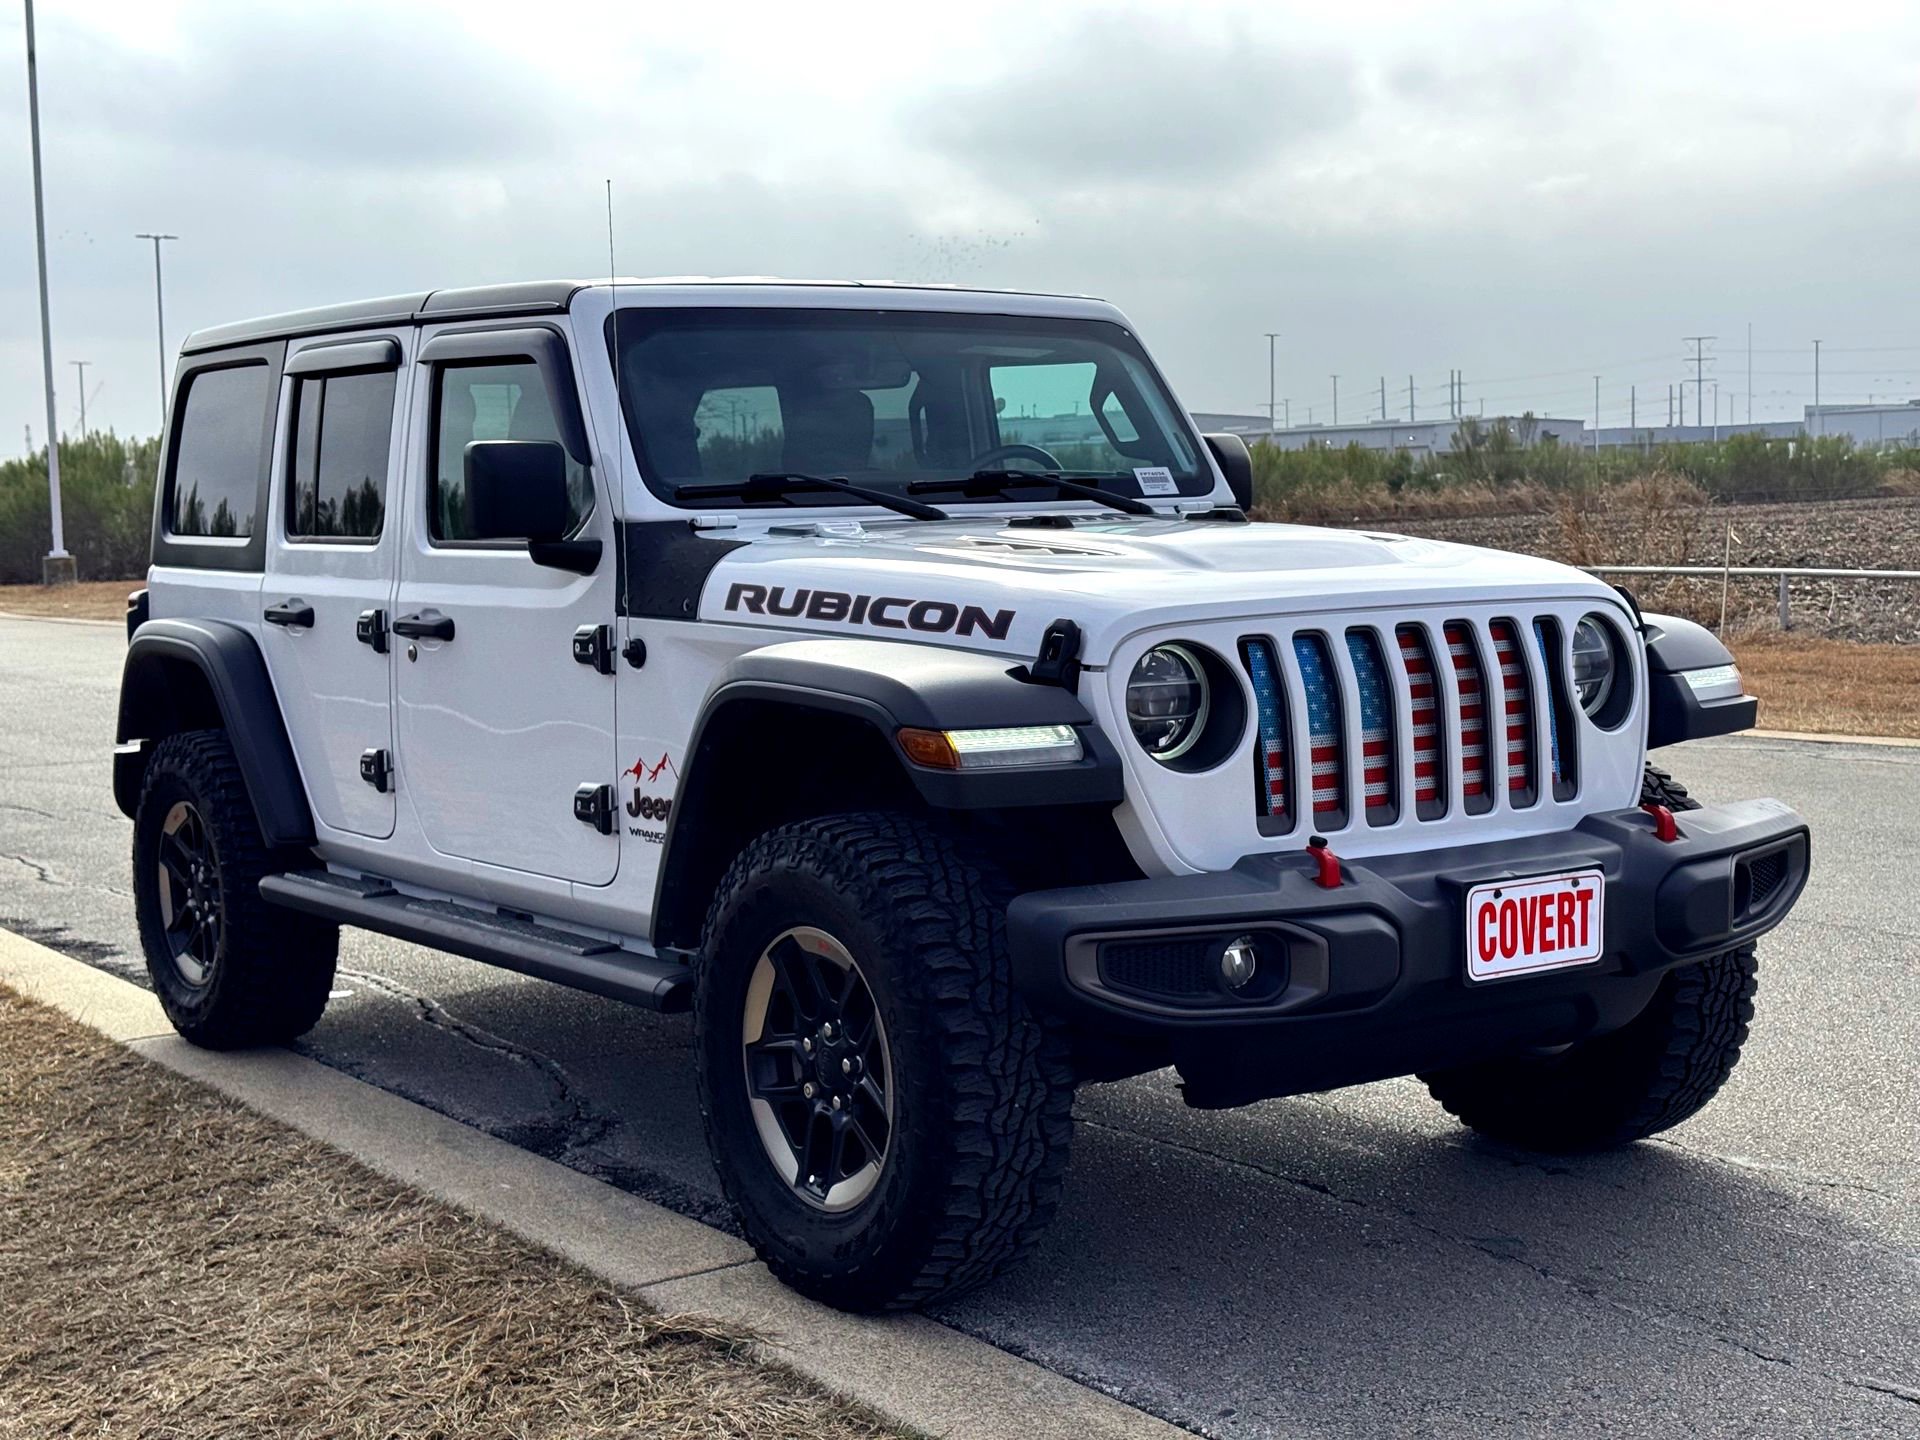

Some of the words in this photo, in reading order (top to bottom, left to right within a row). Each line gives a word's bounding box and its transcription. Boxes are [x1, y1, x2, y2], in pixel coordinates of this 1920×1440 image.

[724, 582, 1016, 640] RUBICON
[629, 826, 666, 840] WRANG
[1478, 888, 1594, 963] COVERT
